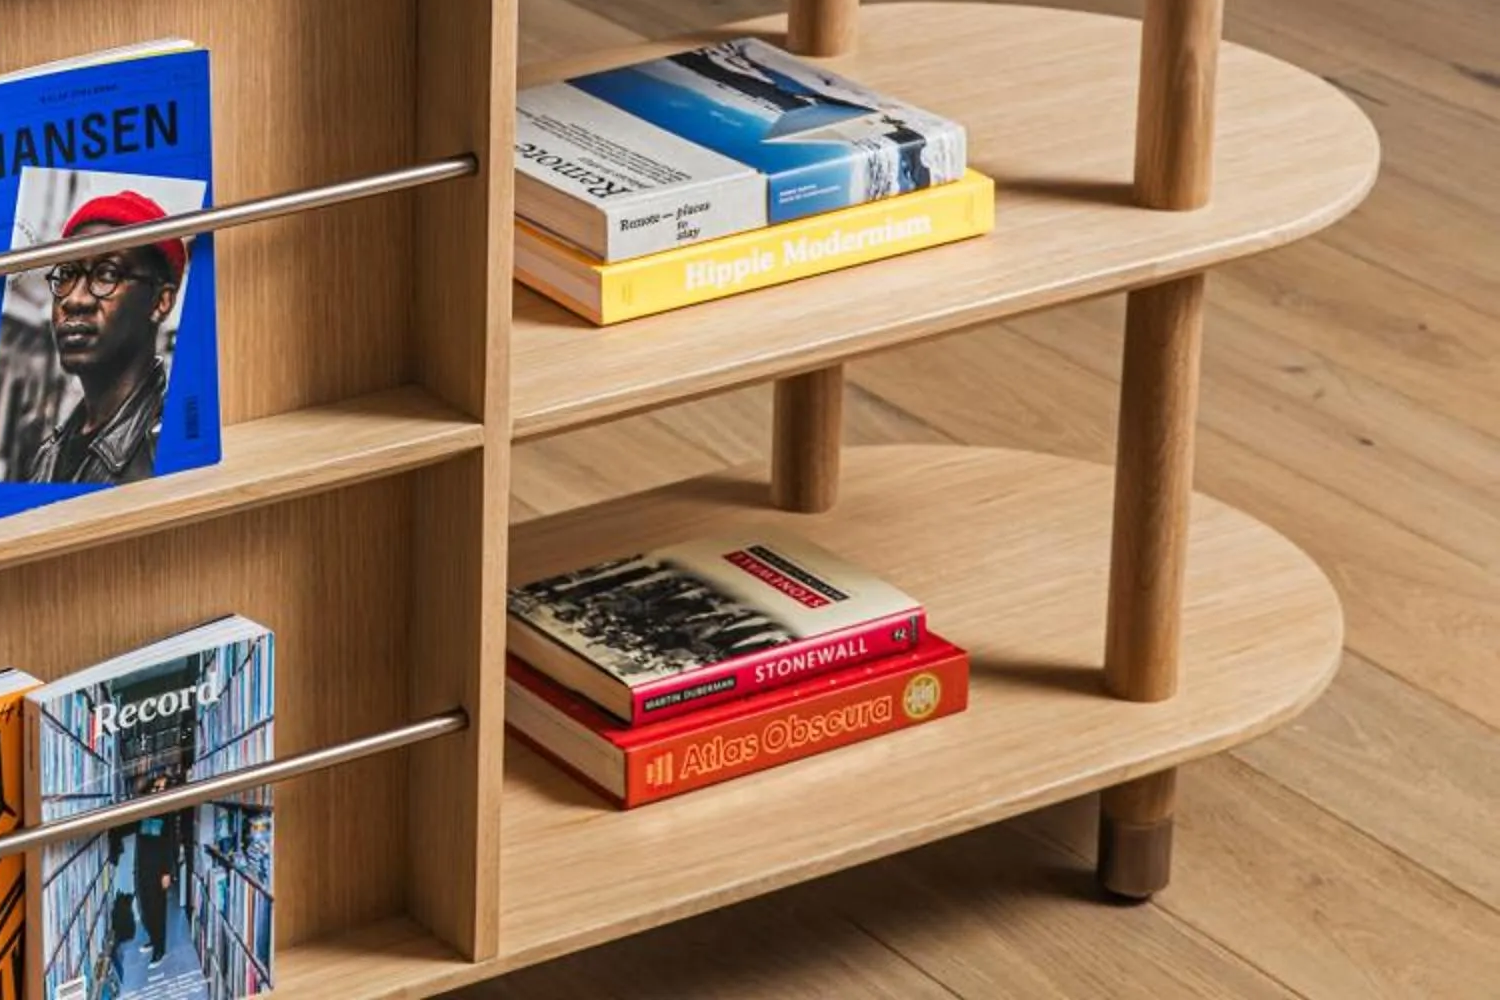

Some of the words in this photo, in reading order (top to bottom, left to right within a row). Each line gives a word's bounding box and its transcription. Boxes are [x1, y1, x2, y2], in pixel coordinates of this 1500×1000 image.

[619, 211, 661, 233] Remote
[684, 248, 777, 291] Hippie
[782, 213, 933, 268] Modernism
[754, 638, 869, 684] STONEWALL
[93, 672, 222, 739] Record
[679, 733, 759, 779] Atlas
[761, 692, 893, 751] Obscura
